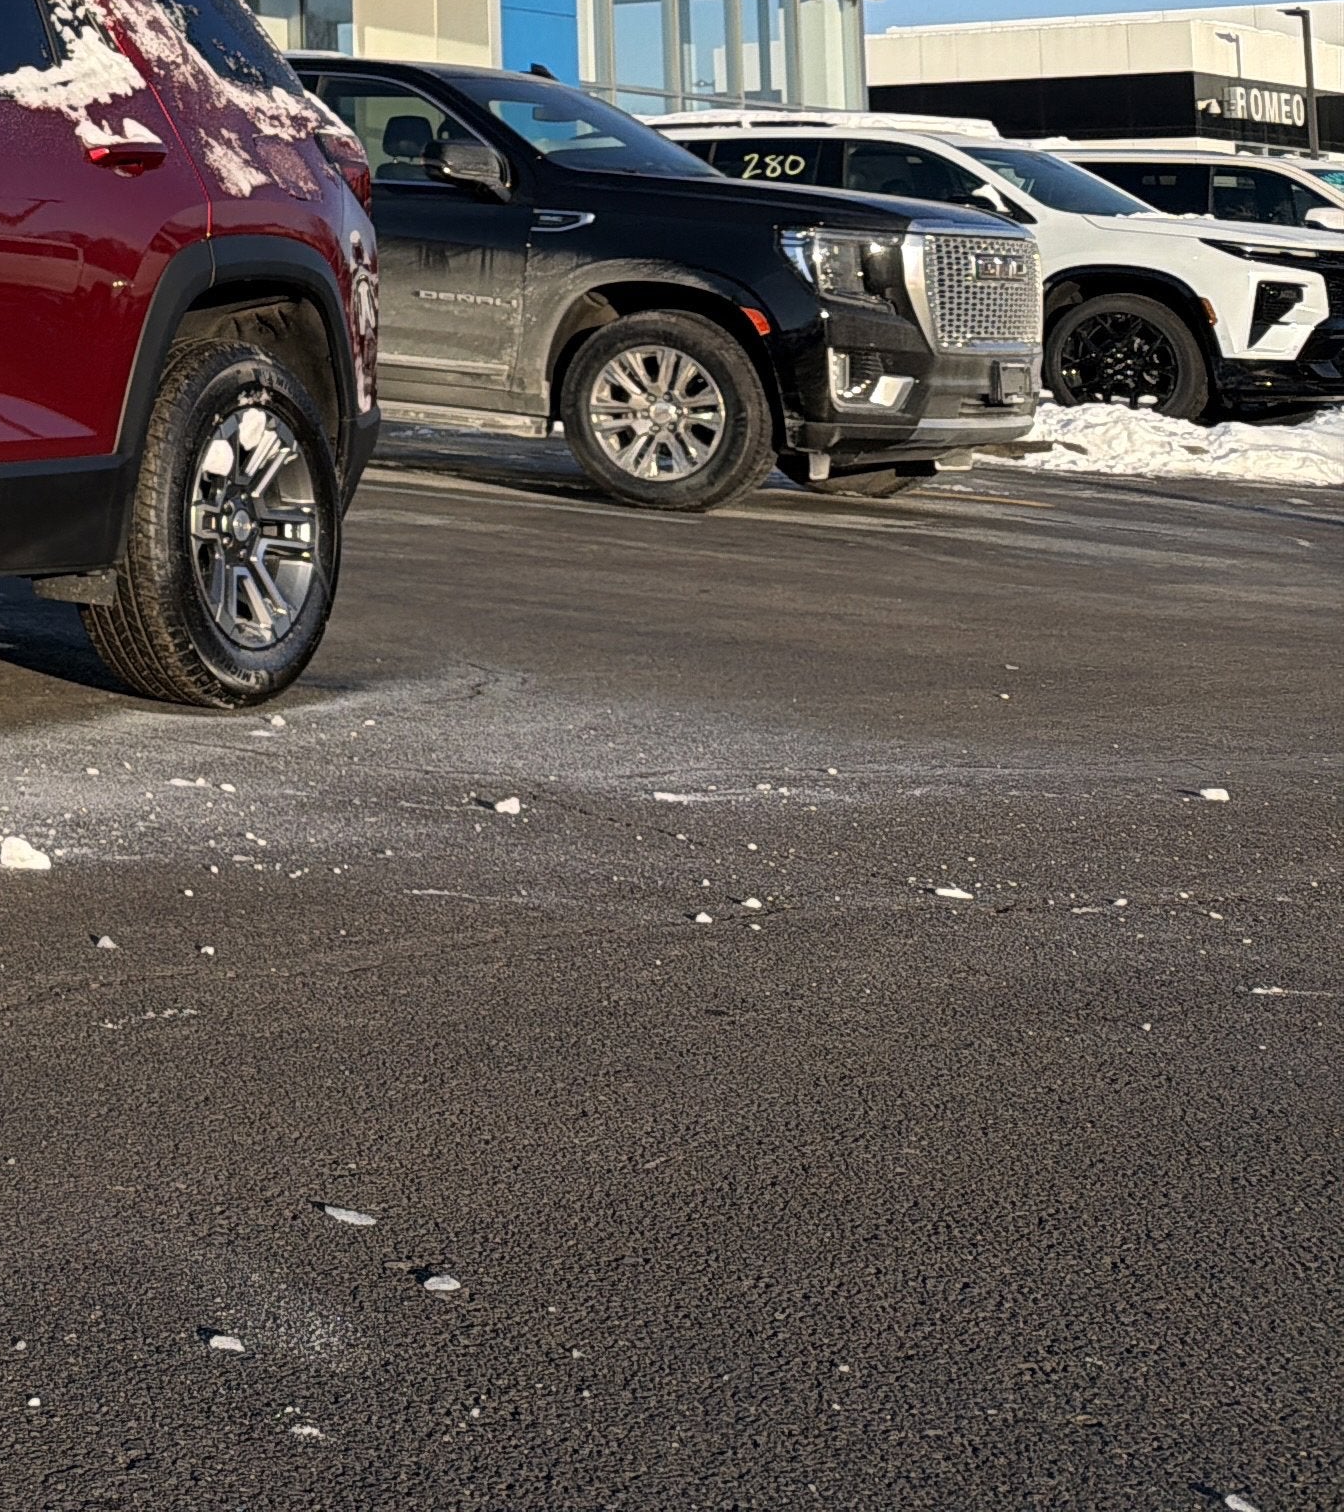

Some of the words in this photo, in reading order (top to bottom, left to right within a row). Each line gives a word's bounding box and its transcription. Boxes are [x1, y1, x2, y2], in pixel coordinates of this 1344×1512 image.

[1235, 86, 1305, 127] ROMEO
[742, 153, 805, 179] 280
[419, 290, 518, 308] DENALI
